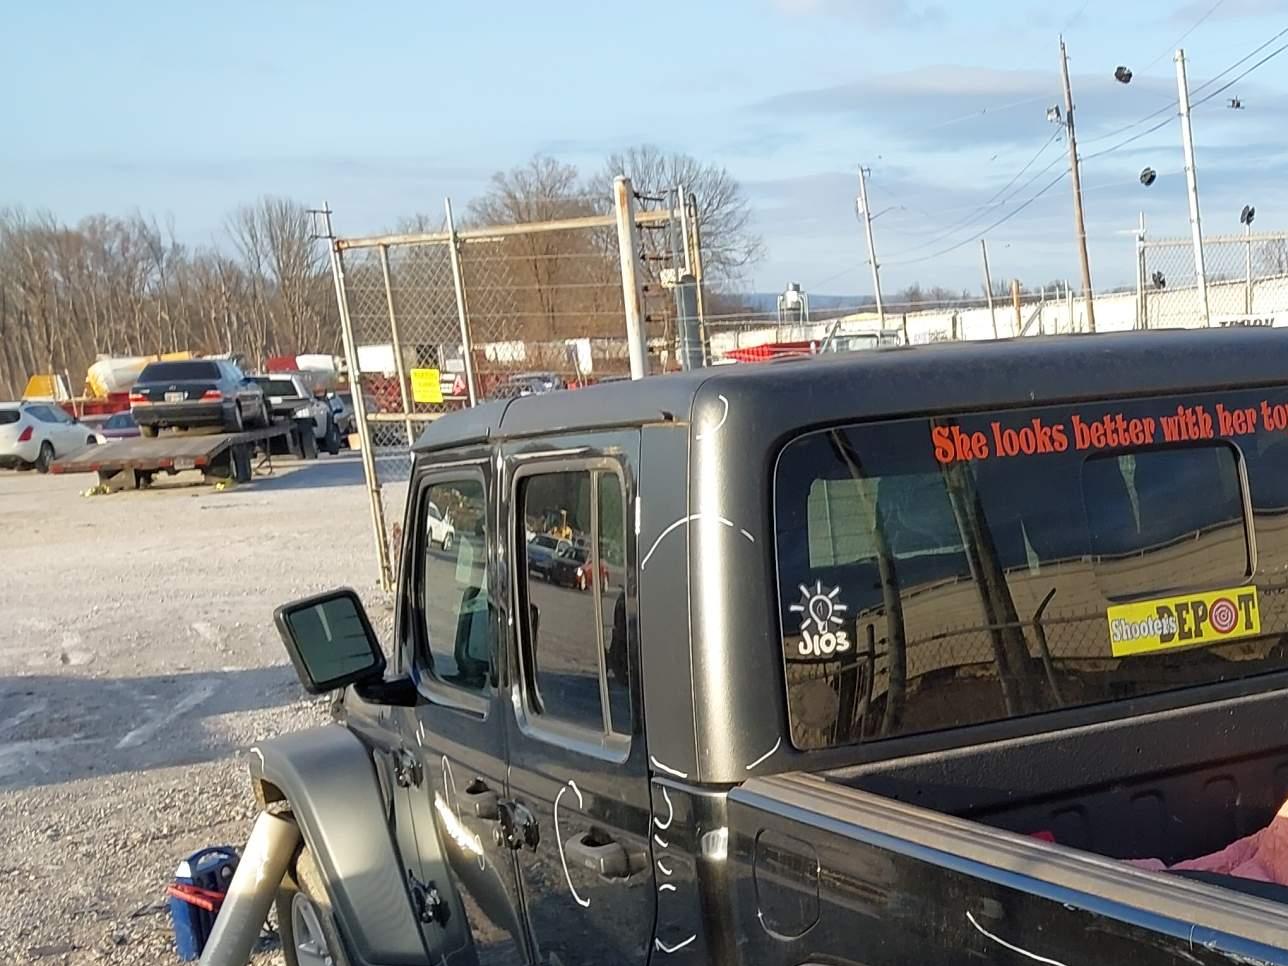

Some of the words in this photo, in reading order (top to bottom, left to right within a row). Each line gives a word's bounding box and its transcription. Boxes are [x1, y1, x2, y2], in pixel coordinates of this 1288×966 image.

[932, 425, 989, 463] She
[991, 417, 1069, 457] looks
[1071, 413, 1156, 450] better
[1160, 404, 1214, 442] with
[1215, 402, 1257, 437] her
